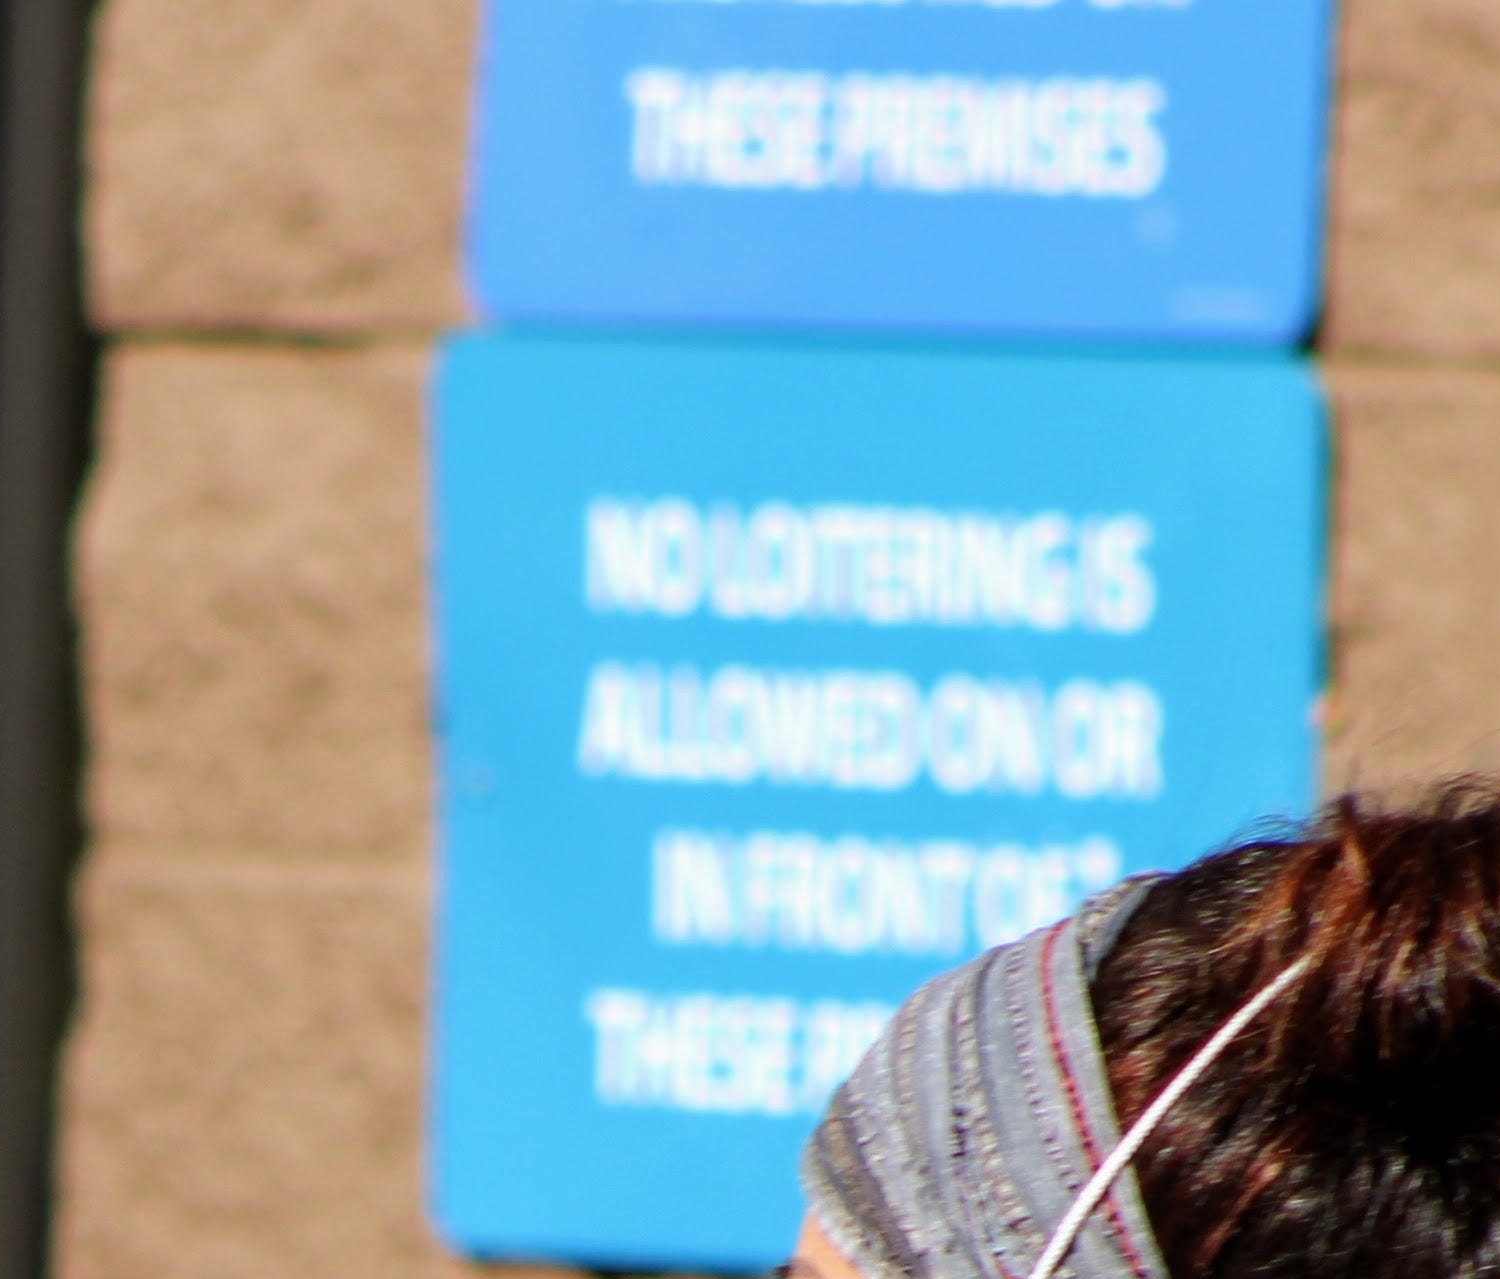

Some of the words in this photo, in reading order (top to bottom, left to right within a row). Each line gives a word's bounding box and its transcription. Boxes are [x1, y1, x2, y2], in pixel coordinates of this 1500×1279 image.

[626, 68, 824, 189] THESE
[828, 70, 1165, 198] PREMISES
[586, 495, 701, 617] NO
[708, 500, 1074, 632] LOITERING
[1078, 512, 1156, 634] IS
[577, 662, 920, 790] ALLOWED
[928, 675, 1044, 794] ON
[1053, 680, 1163, 800] OR
[653, 828, 731, 944] IN
[736, 830, 973, 954] FRONT
[586, 986, 797, 1115] THESE
